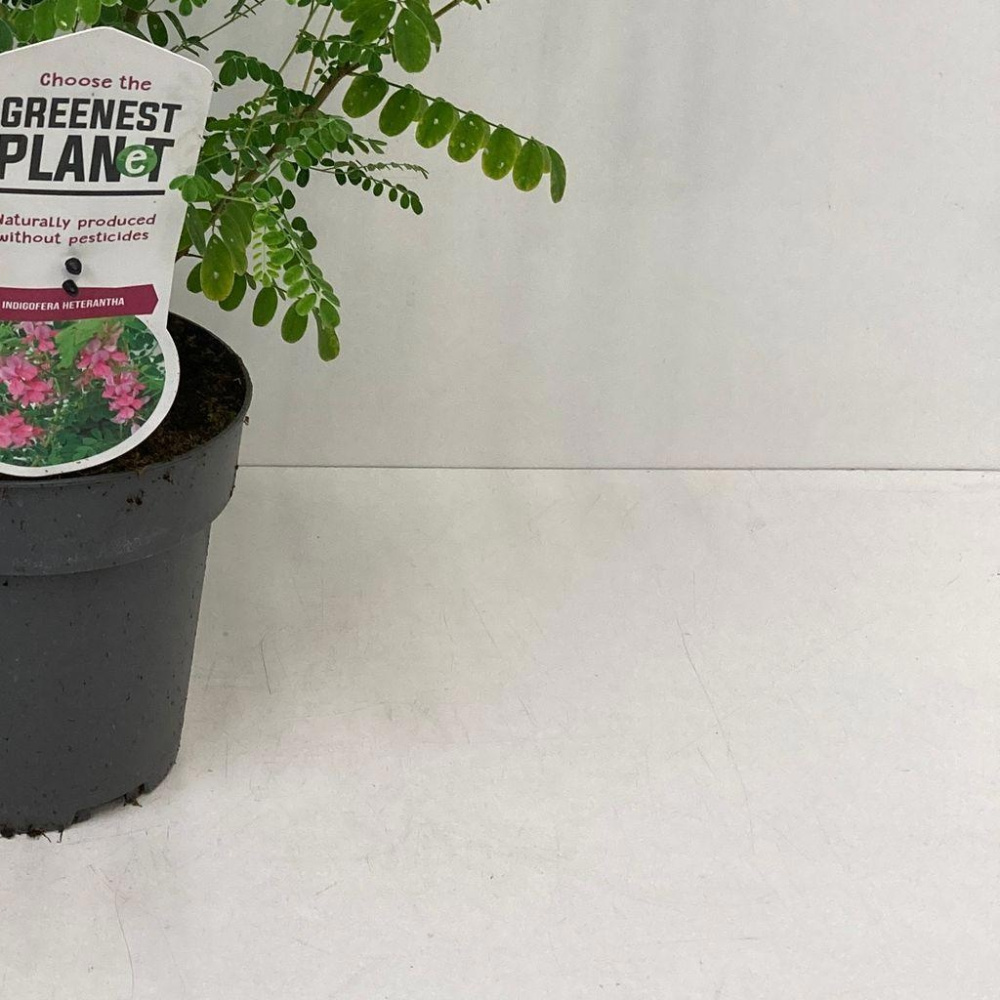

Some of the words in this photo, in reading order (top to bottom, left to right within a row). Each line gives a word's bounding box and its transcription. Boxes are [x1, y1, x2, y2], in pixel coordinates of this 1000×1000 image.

[40, 73, 112, 88] Choose
[120, 76, 152, 91] the
[0, 96, 182, 132] GREENEST
[77, 214, 157, 230] produced
[68, 231, 149, 246] pesticides
[1, 300, 60, 311] INDIGOFERA
[62, 297, 125, 310] HETERANTHA
